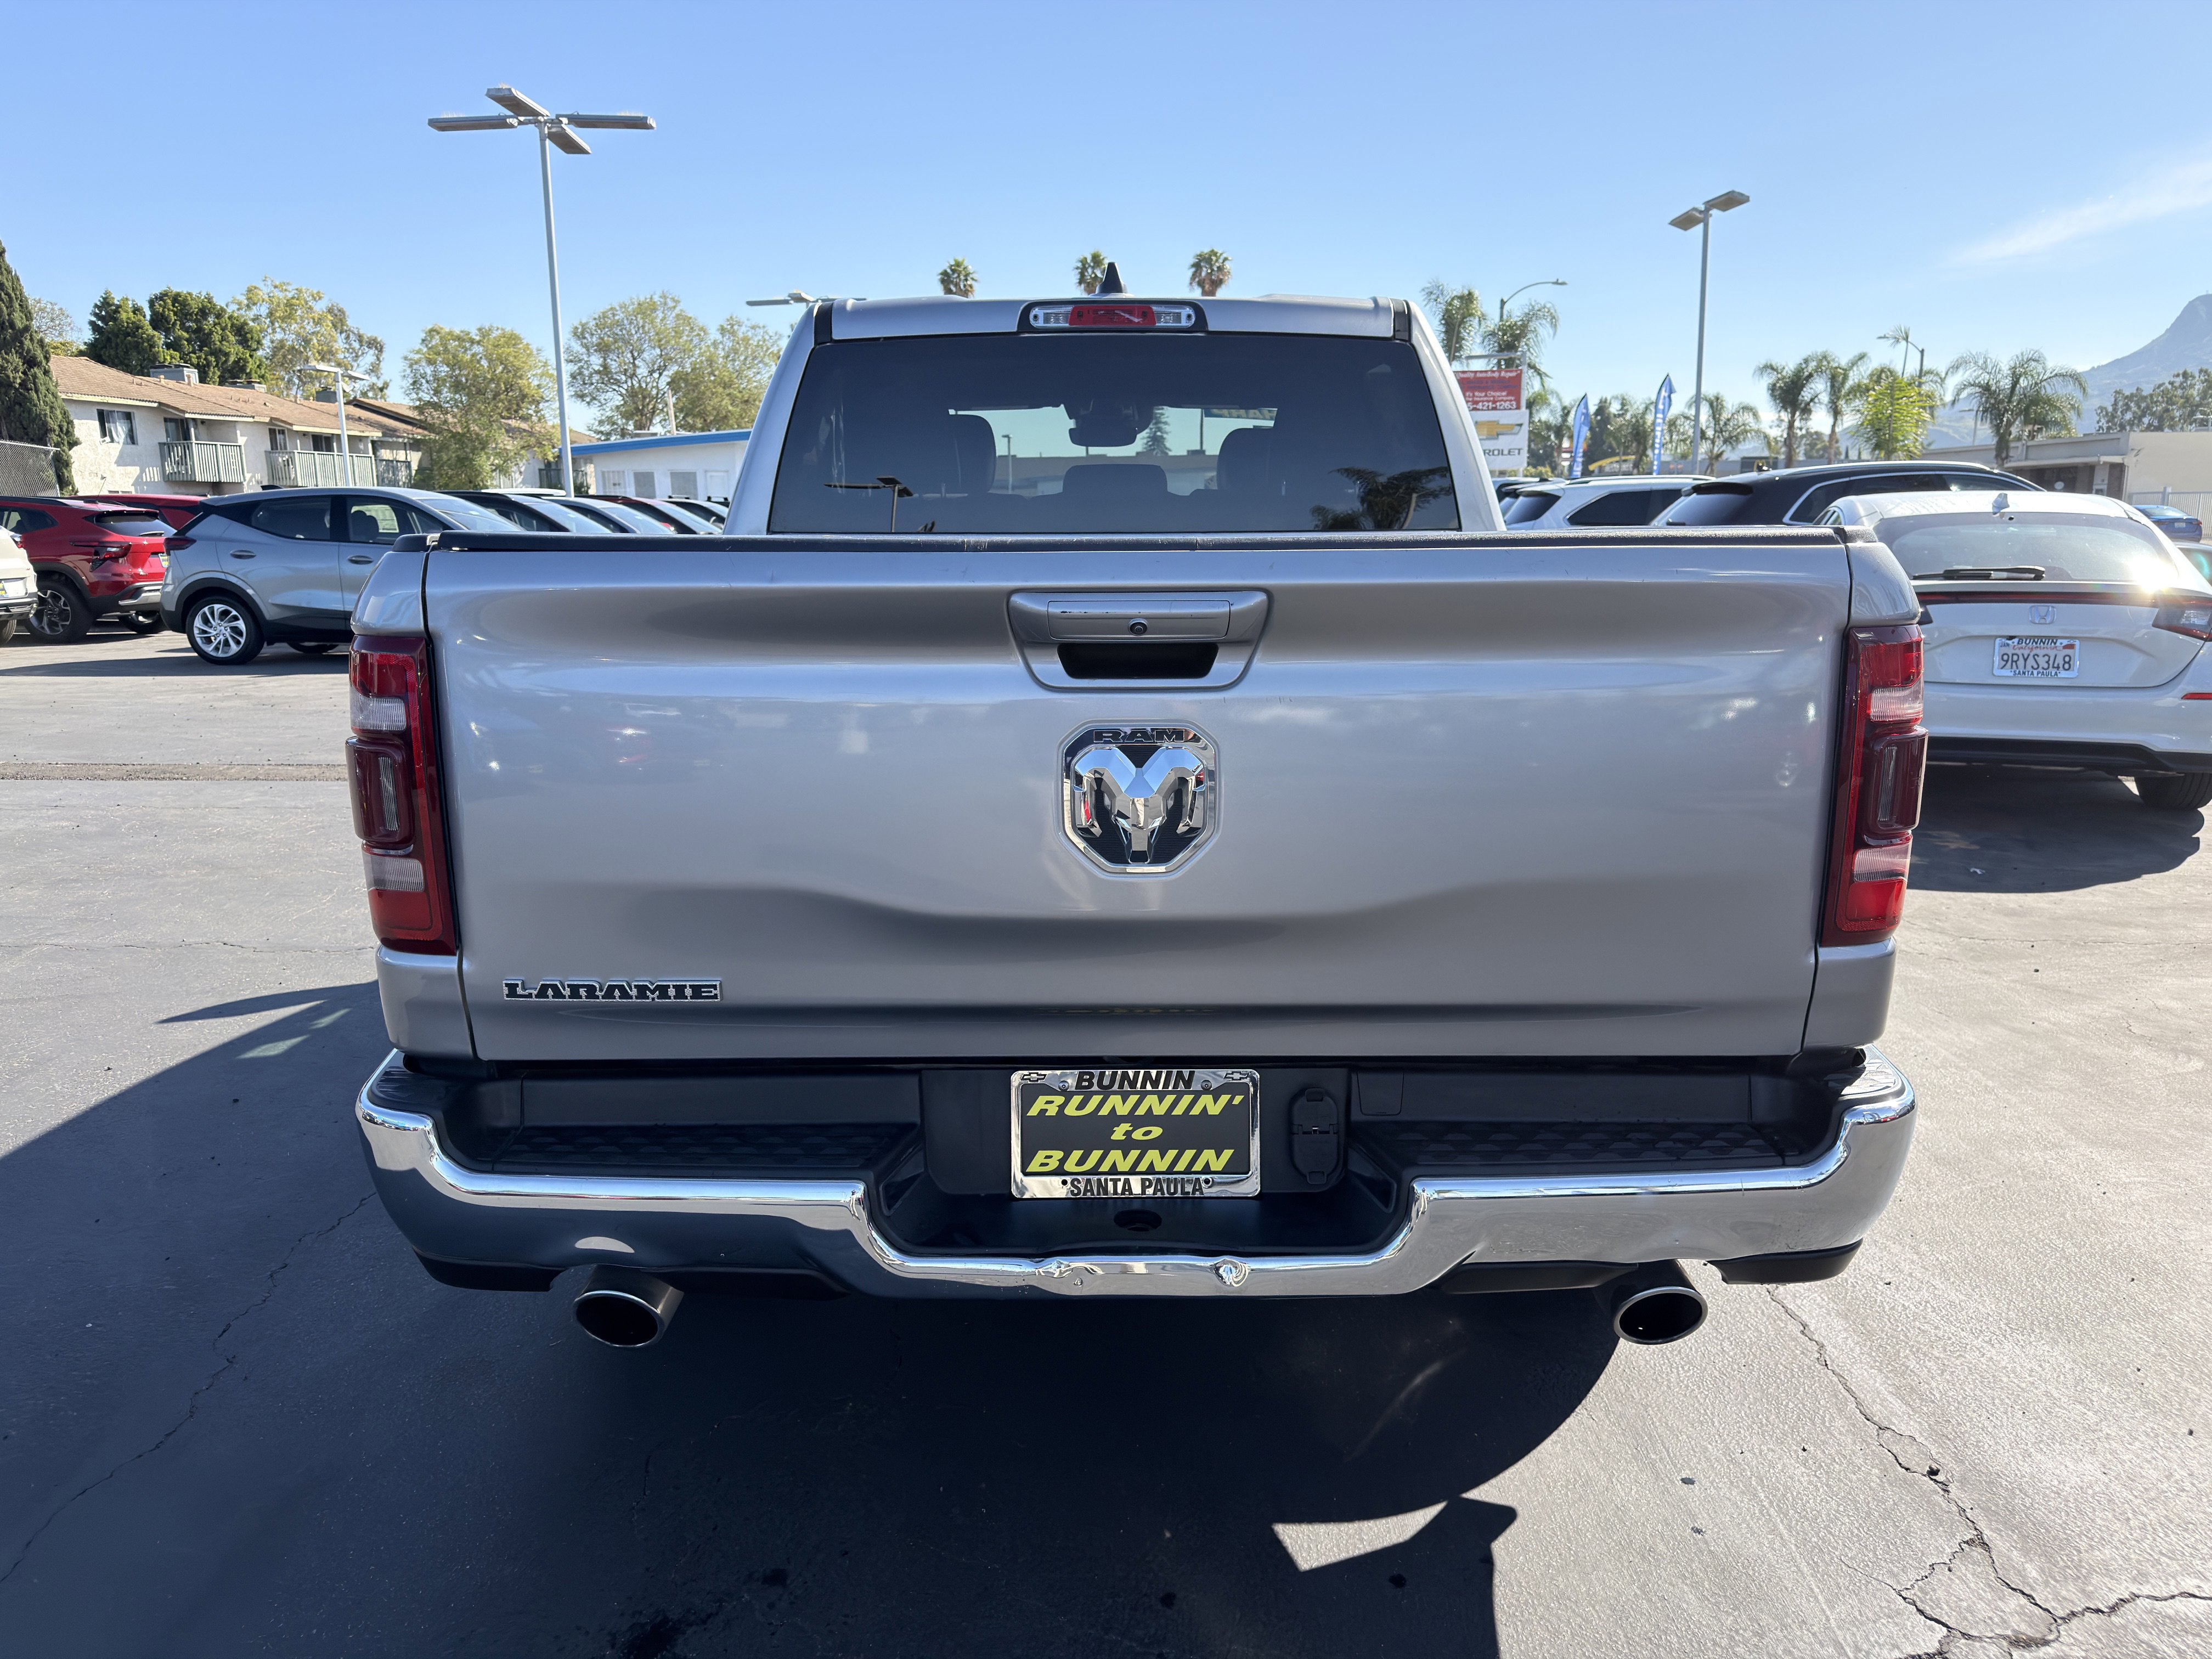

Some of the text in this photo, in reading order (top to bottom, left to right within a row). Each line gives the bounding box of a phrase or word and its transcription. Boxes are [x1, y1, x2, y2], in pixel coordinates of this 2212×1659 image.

[2000, 653, 2072, 671] 9RYS348
[1093, 730, 1185, 742] RAM
[503, 980, 721, 1002] LARAMIE
[1075, 1070, 1195, 1090] BUNNIN
[1026, 1094, 1244, 1116] RUNNIN'
[1110, 1123, 1163, 1140] to
[1025, 1149, 1234, 1172] BUNNIN
[1070, 1177, 1204, 1197] SANTA PAULA
